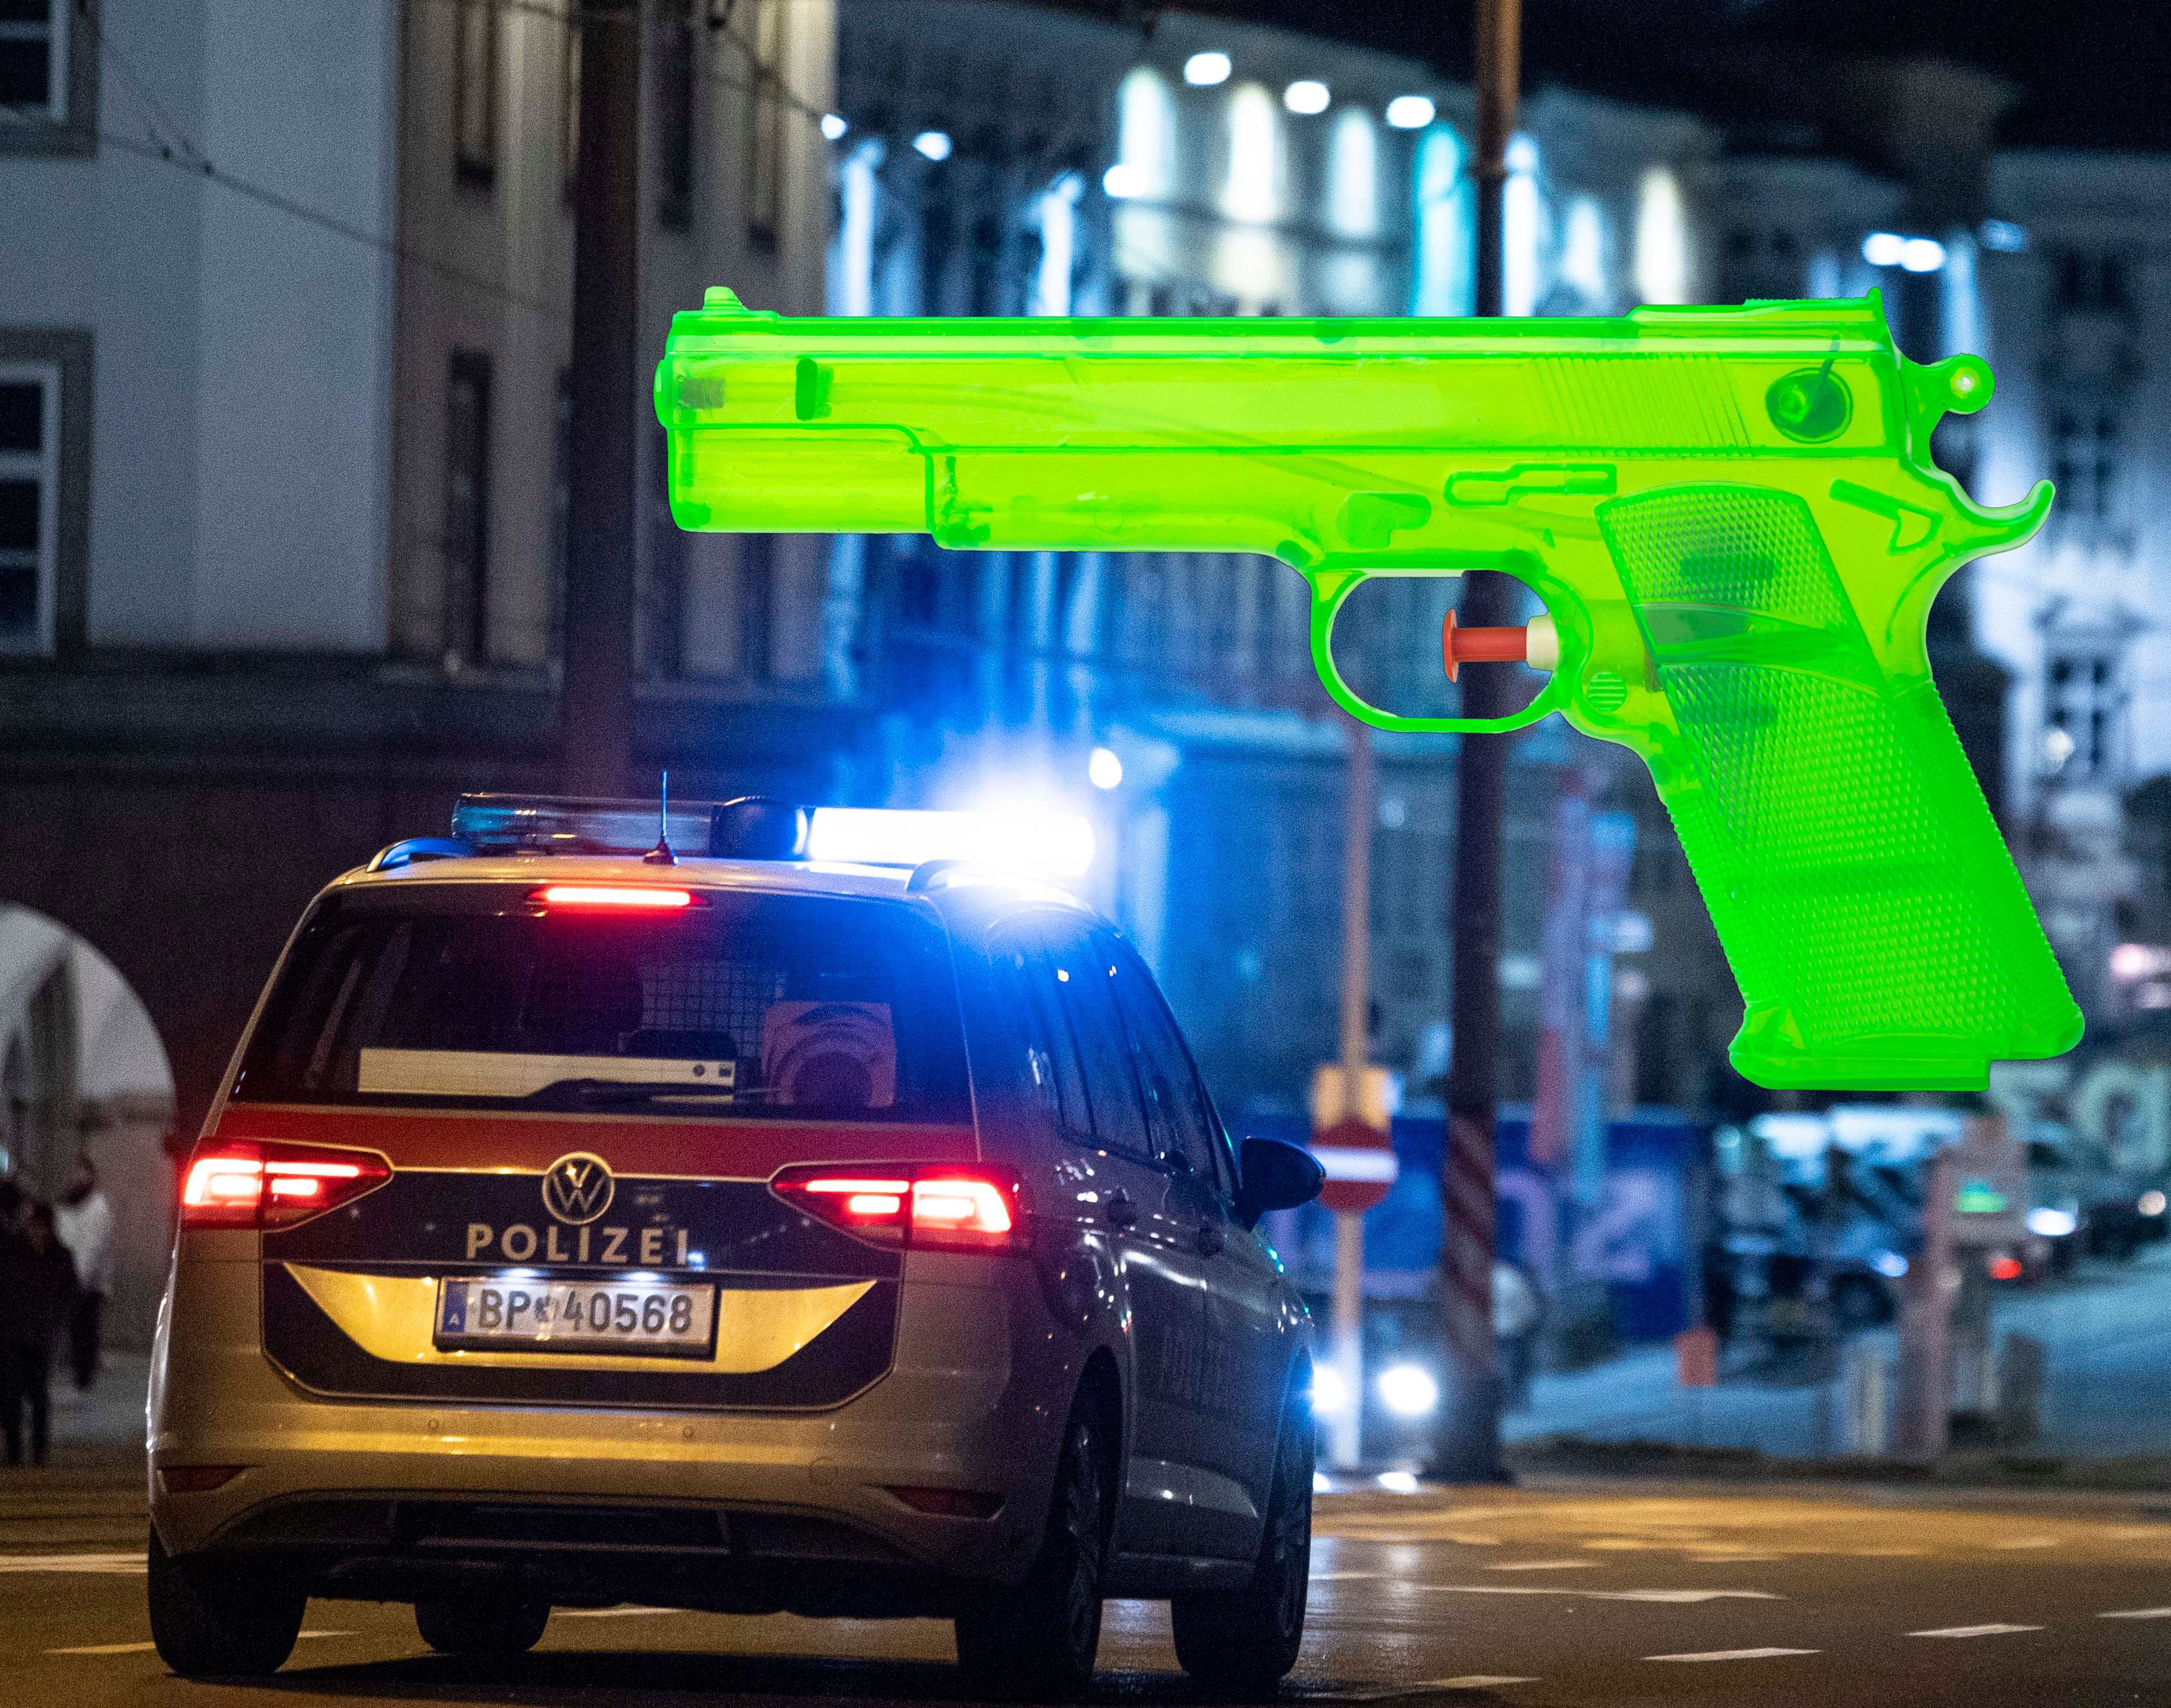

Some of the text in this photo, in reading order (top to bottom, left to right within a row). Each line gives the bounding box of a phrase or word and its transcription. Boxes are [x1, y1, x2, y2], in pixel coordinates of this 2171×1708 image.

[549, 1157, 610, 1217] VW
[466, 1223, 688, 1266] POLIZEI
[449, 1288, 693, 1334] A BP 40568
